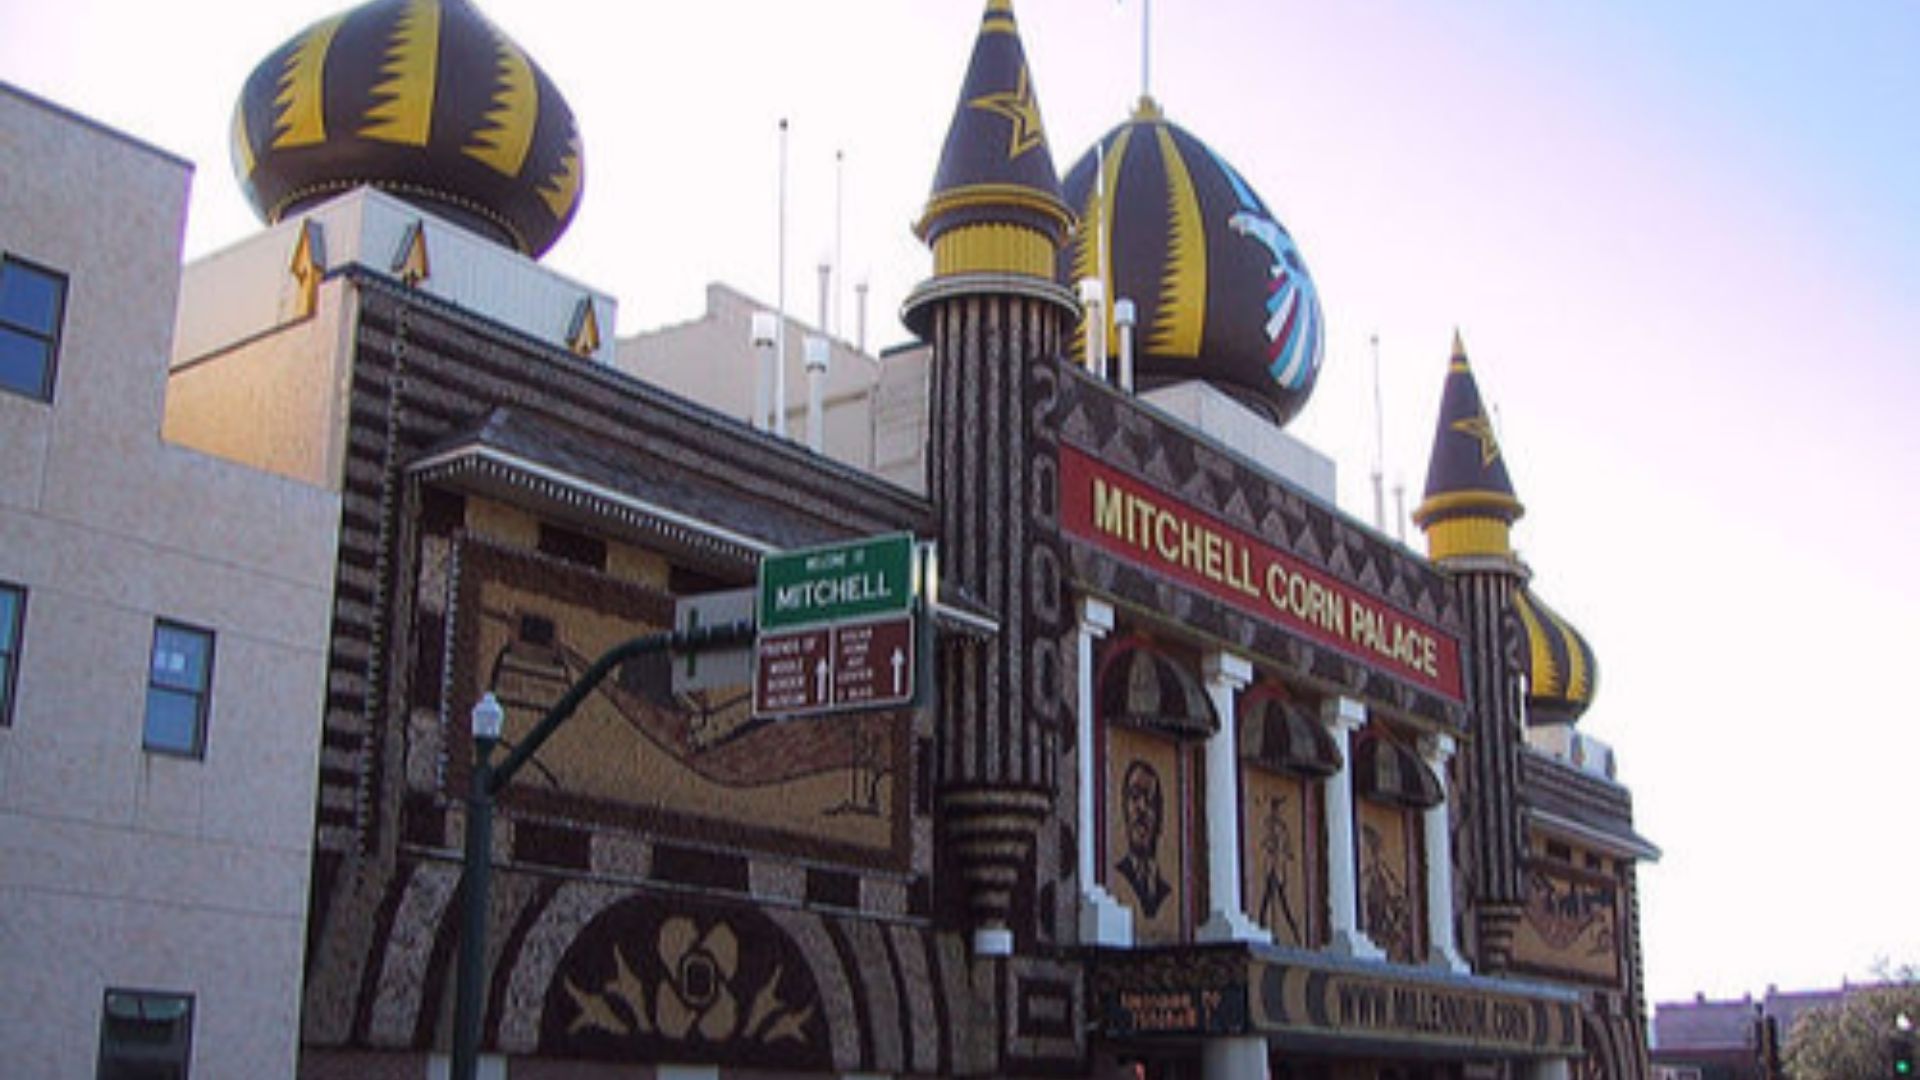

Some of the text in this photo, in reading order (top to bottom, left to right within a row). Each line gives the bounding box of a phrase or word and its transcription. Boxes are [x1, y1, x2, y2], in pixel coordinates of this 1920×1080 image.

[775, 569, 891, 611] MITCHELL
[1093, 478, 1438, 678] MITCHELL CORN PALACE
